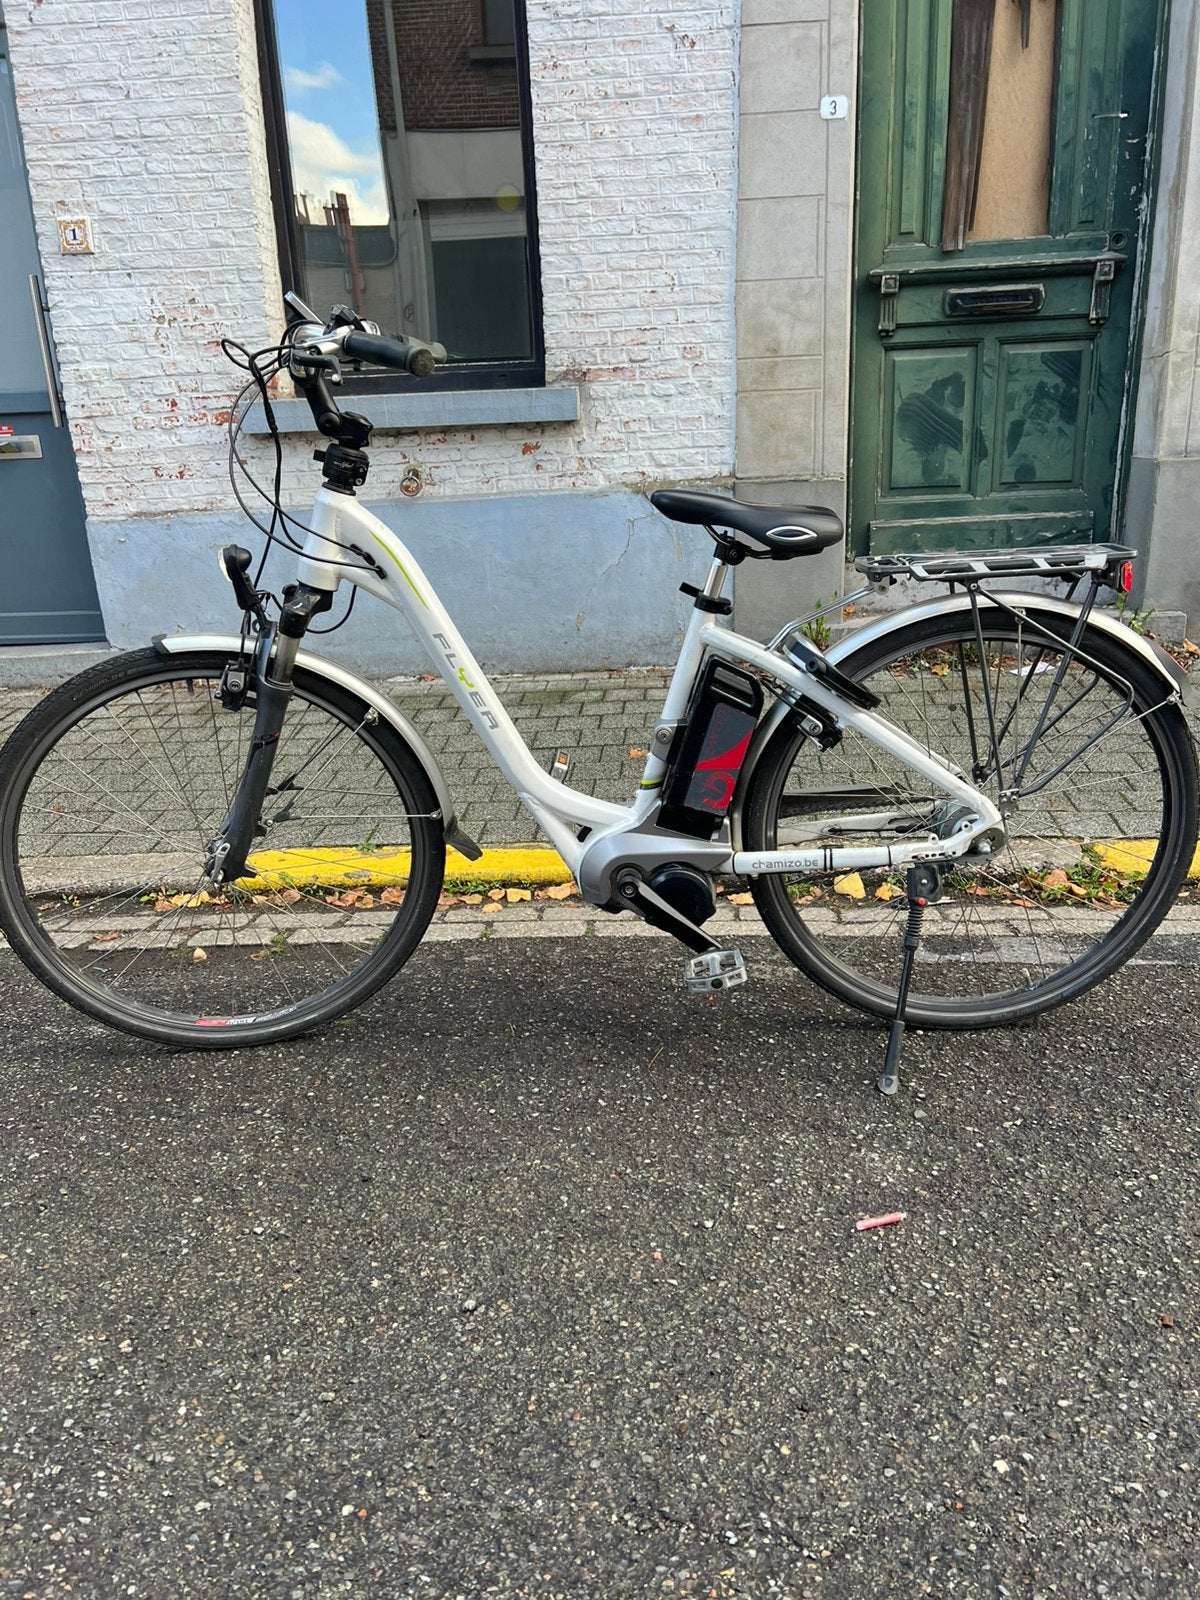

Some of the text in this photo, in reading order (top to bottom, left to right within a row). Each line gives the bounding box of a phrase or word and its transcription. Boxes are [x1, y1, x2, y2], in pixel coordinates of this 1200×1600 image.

[830, 100, 837, 115] 3
[69, 228, 79, 240] 1
[432, 633, 499, 730] FLYER
[752, 858, 819, 869] chamizo.be
